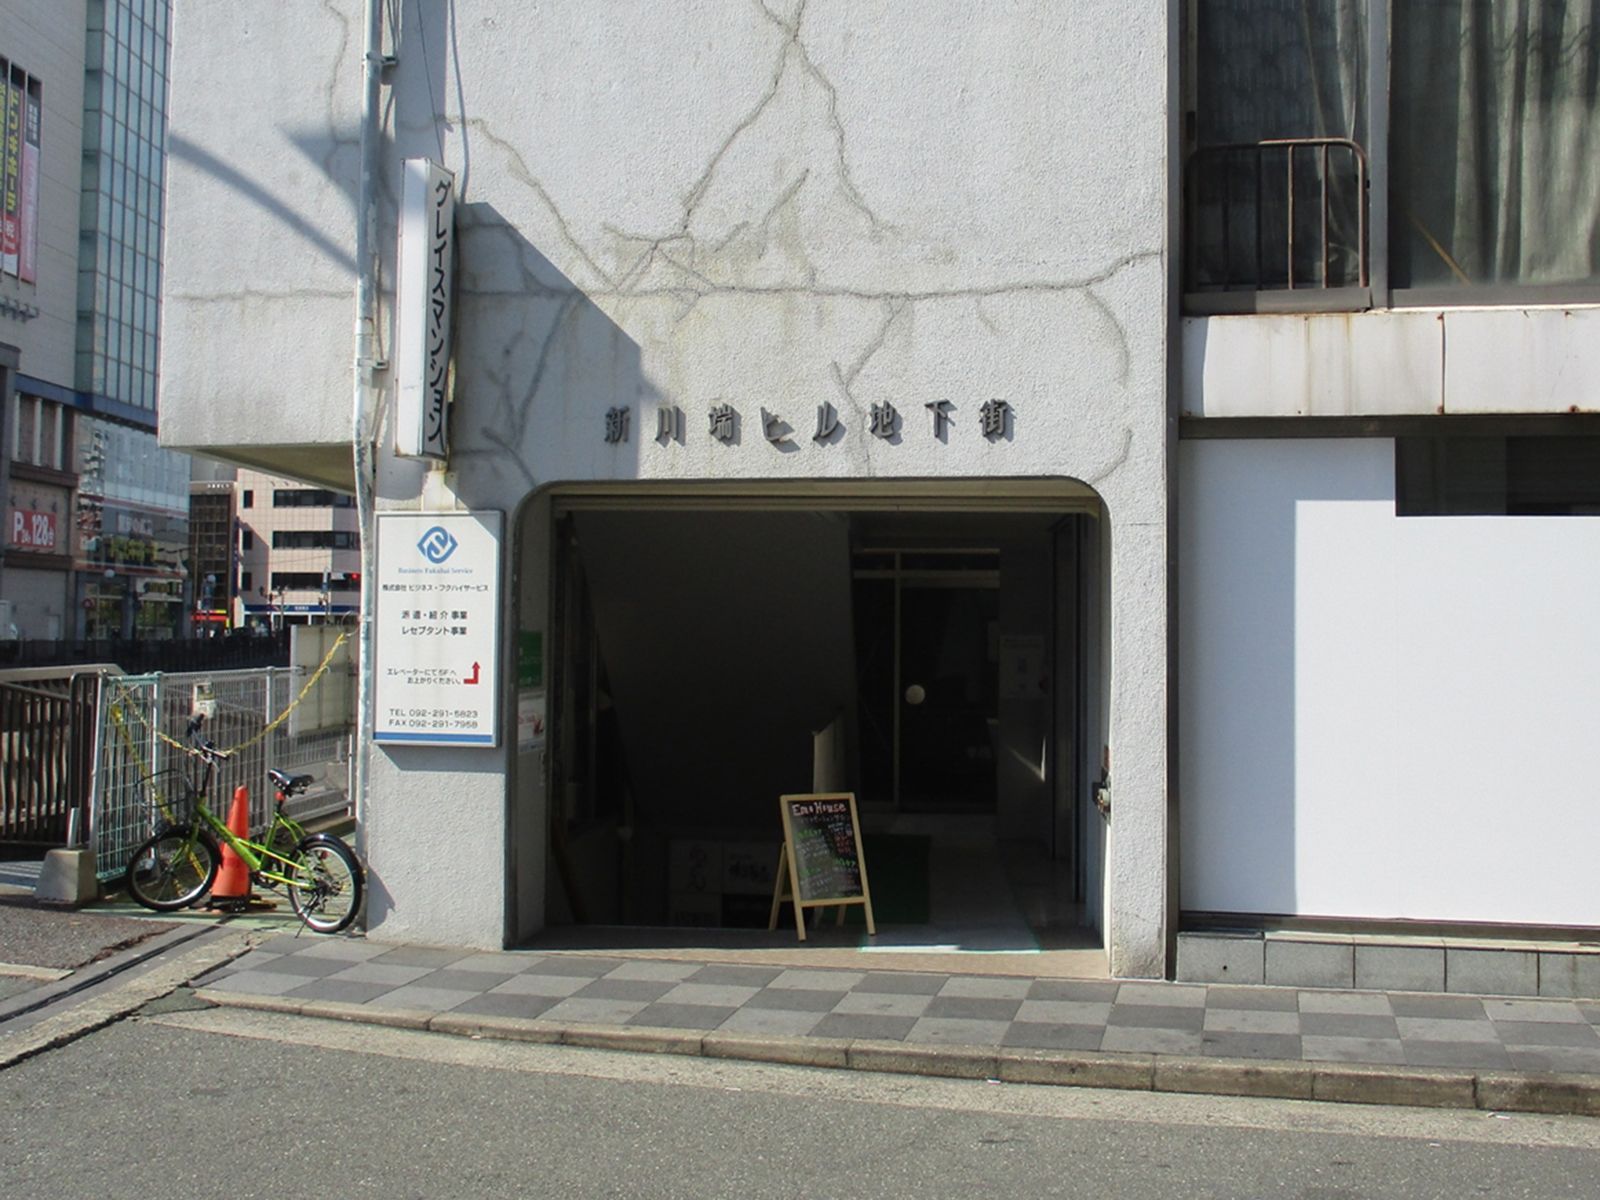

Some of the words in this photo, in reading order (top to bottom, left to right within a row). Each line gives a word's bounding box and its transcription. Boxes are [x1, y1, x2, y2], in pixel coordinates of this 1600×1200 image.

[428, 179, 452, 453] グレイスマンション
[382, 583, 407, 592] 株式会社
[389, 708, 406, 717] TEL
[388, 719, 407, 727] FAX
